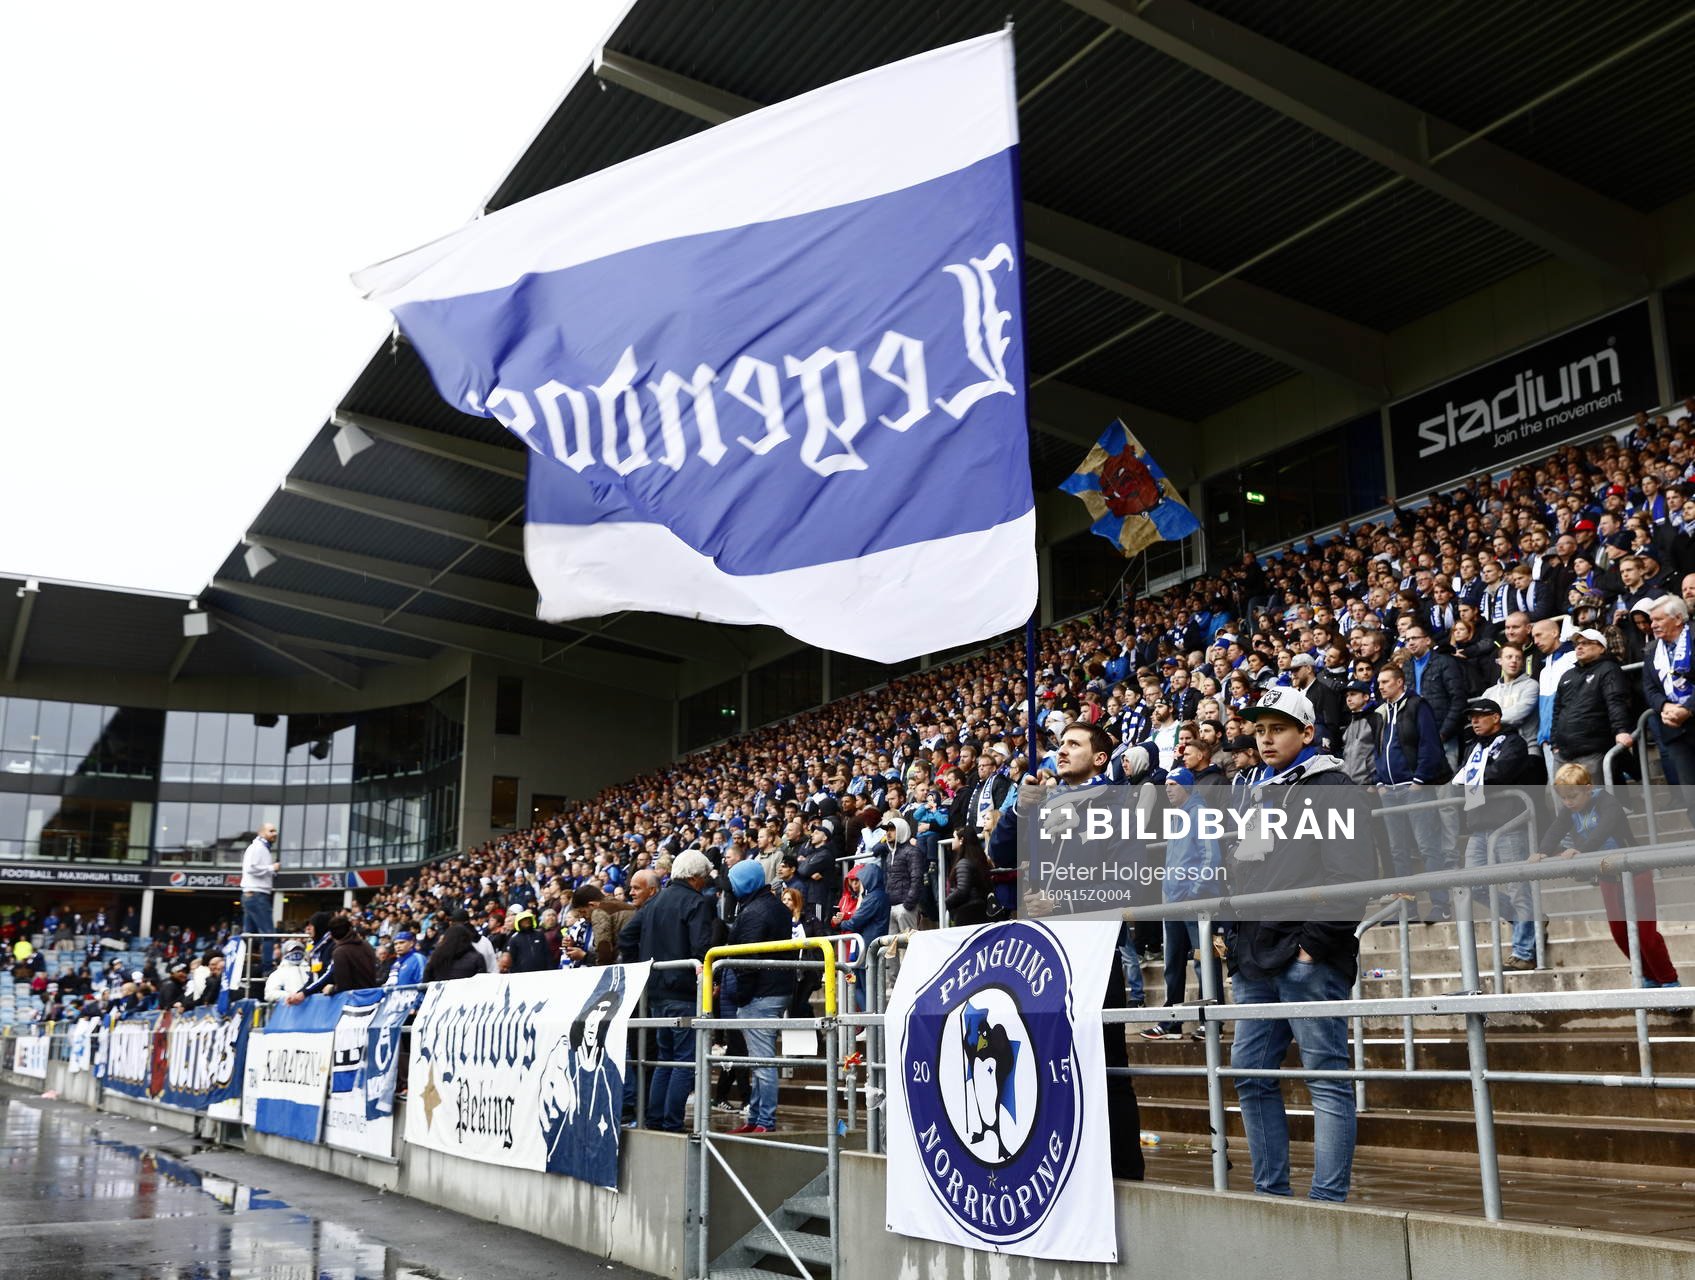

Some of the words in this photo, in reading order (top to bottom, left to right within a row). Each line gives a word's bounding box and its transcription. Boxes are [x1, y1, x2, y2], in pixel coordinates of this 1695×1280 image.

[1418, 348, 1621, 458] stadium
[1493, 430, 1518, 448] Join
[1520, 421, 1543, 437] the
[1545, 388, 1624, 430] movement
[57, 870, 110, 882] MAXIMUM
[112, 872, 143, 884] TASTE.
[188, 873, 223, 887] pepsi
[939, 937, 1053, 1005] PENGUINS
[913, 1060, 931, 1083] 20
[1049, 1055, 1071, 1084] 15
[456, 1076, 515, 1150] Peking
[919, 1121, 1063, 1227] NORRKÖPING
